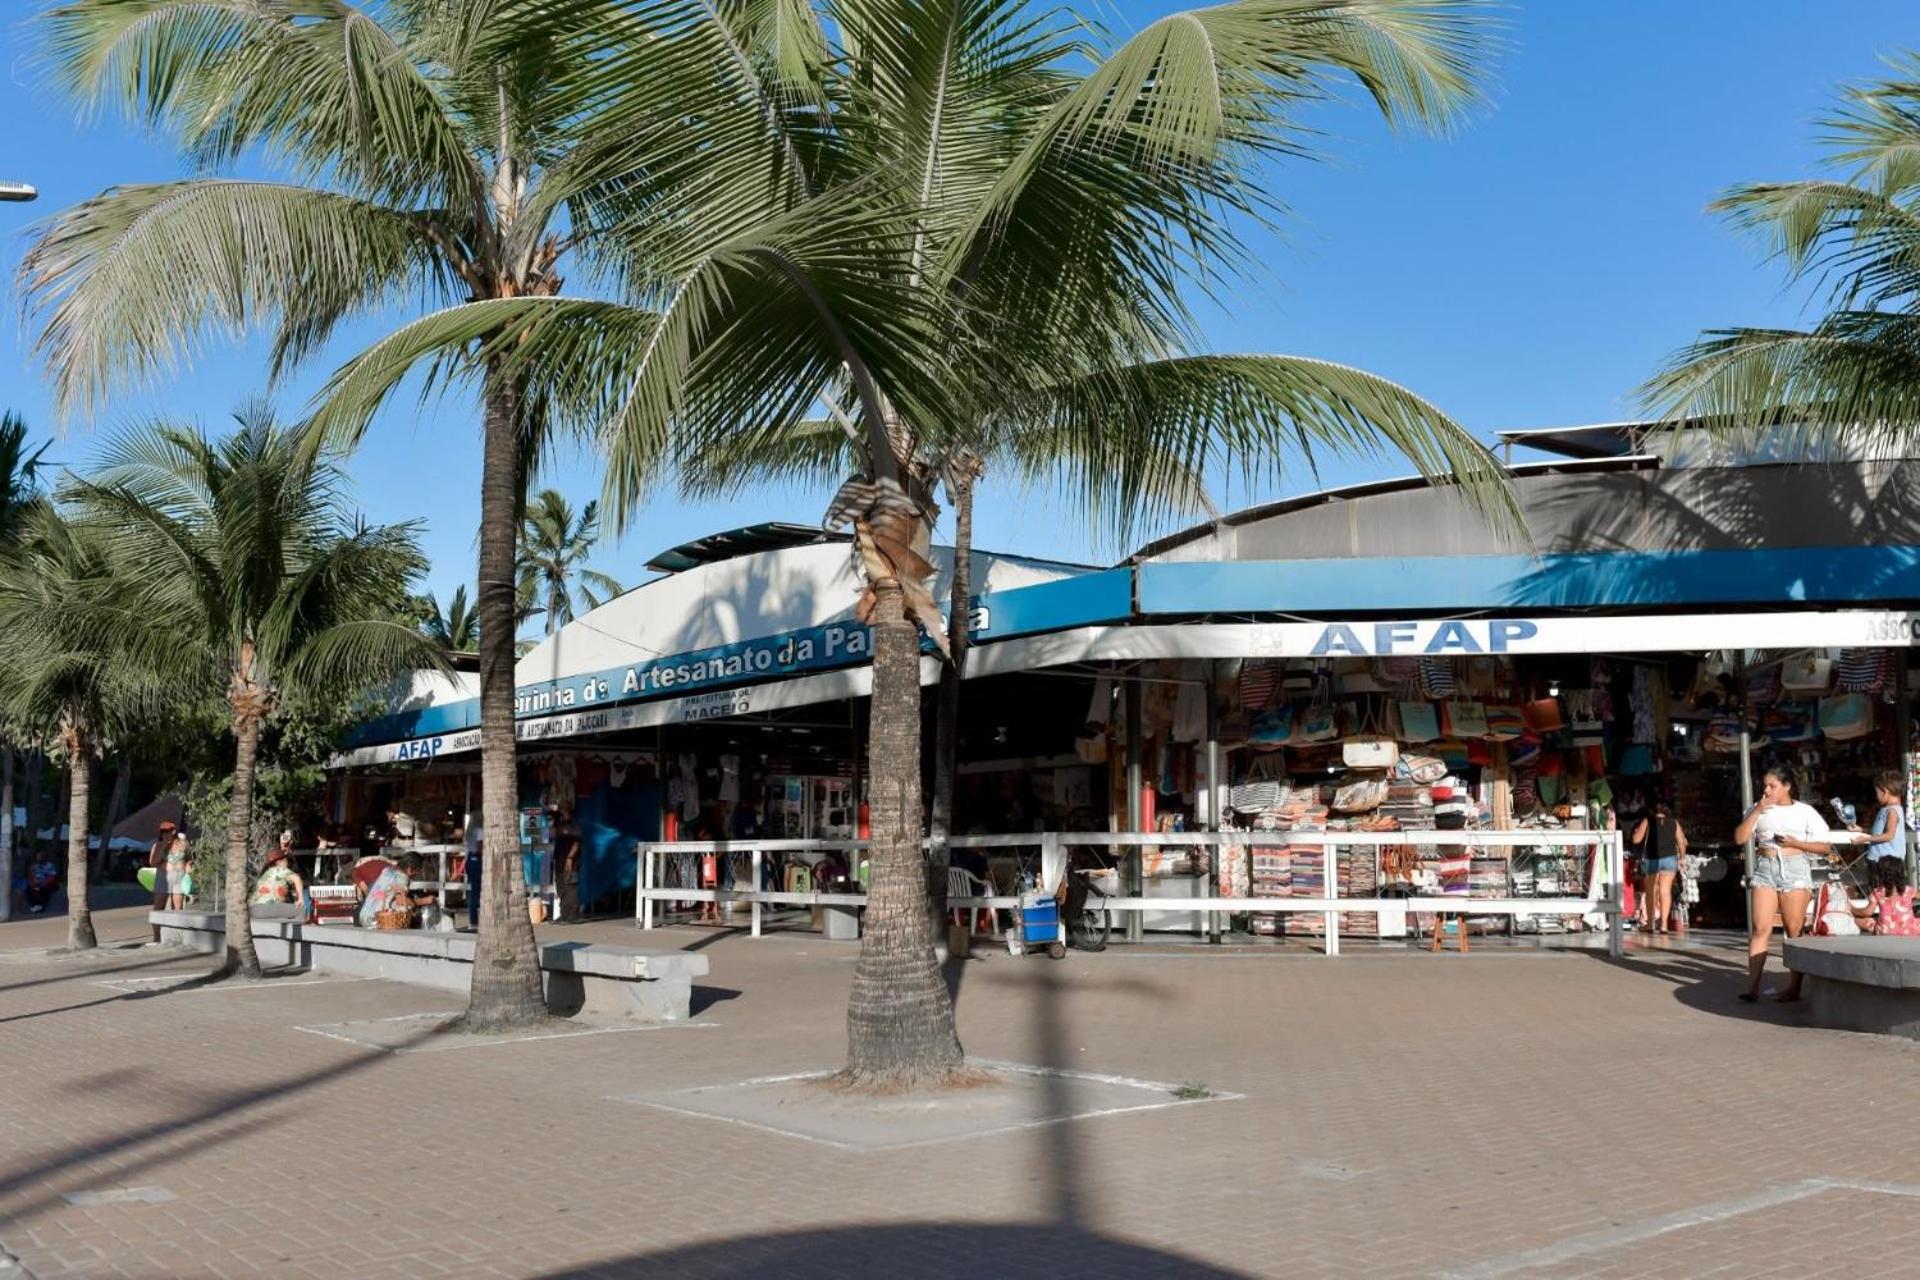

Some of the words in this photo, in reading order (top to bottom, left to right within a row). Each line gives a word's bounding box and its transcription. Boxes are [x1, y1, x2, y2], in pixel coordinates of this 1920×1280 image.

[1309, 620, 1538, 656] AFAP
[622, 646, 772, 694] Artesanato
[778, 637, 814, 664] da
[685, 698, 750, 720] MACEIÓ
[398, 738, 442, 760] AFAP
